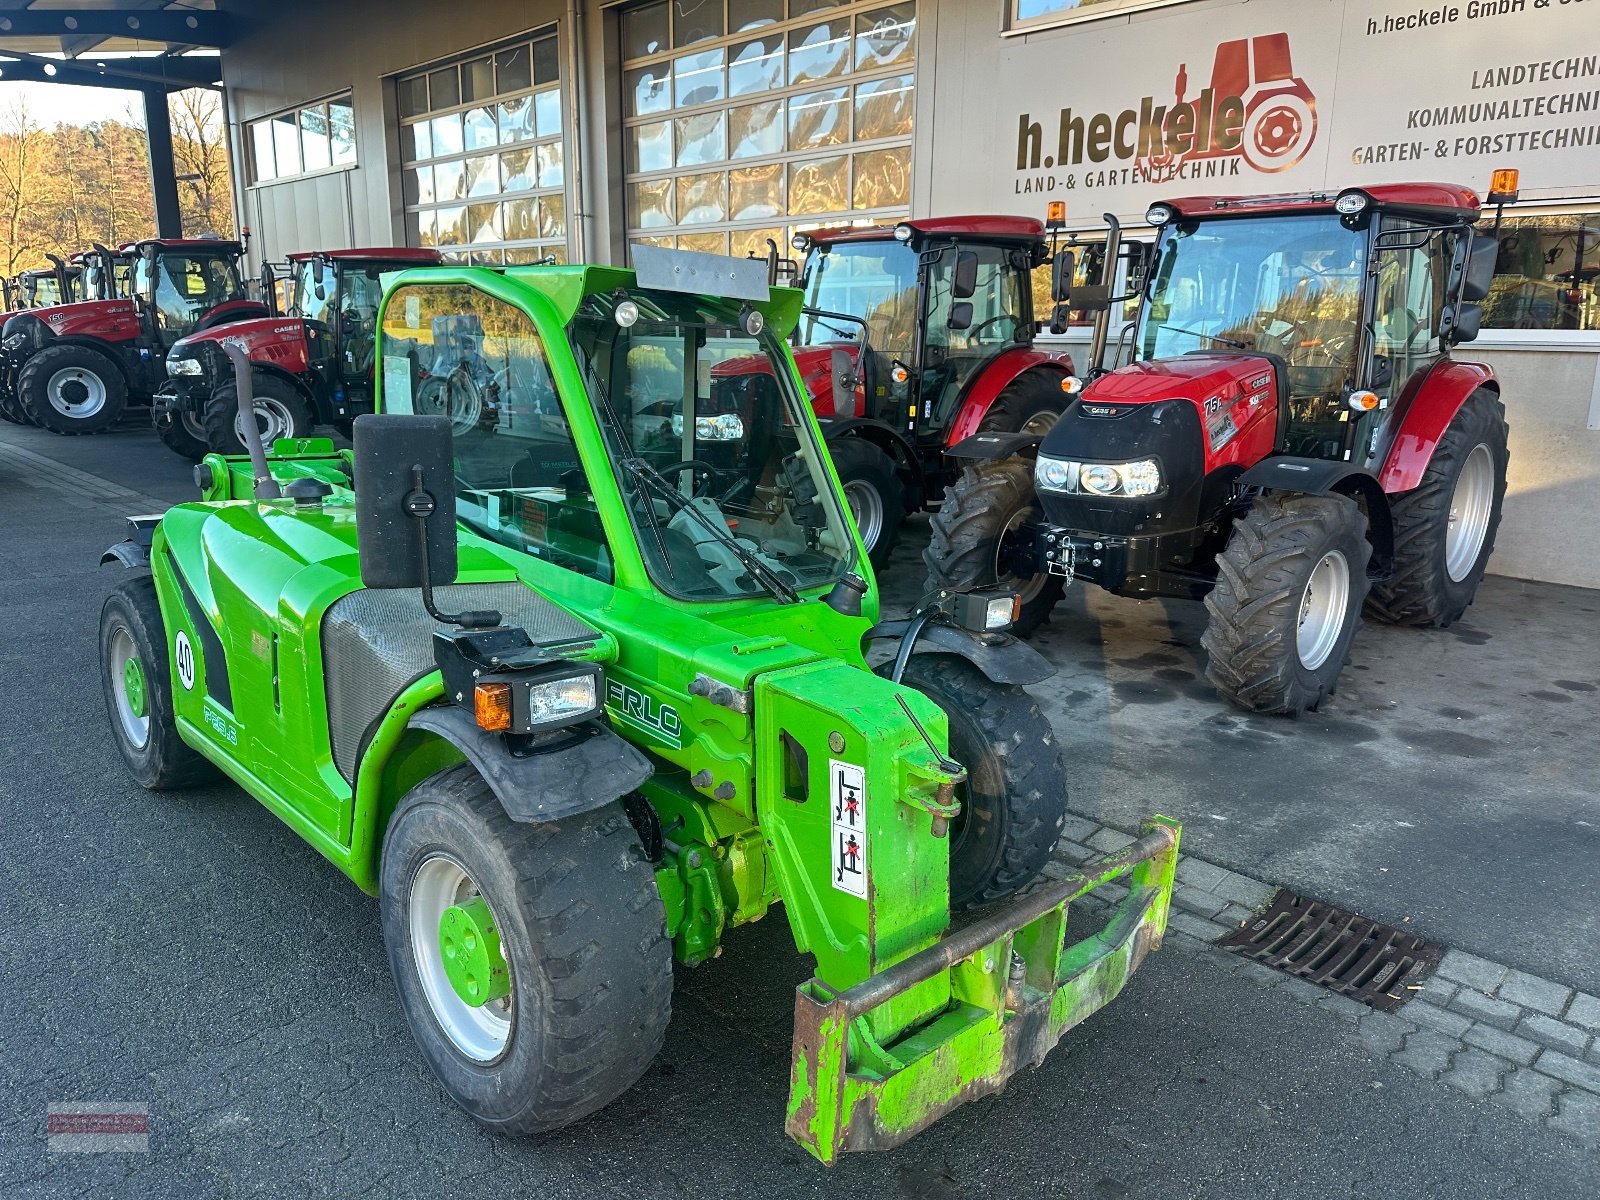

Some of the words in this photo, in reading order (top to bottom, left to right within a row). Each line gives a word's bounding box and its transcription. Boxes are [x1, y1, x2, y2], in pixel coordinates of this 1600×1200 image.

[1366, 4, 1460, 36] h.heckele
[1471, 54, 1600, 90] LANDTECHN
[1016, 87, 1245, 171] h.heckele
[1352, 141, 1430, 165] GARTEN-
[1434, 139, 1448, 158] &
[1085, 157, 1241, 188] GARTENTECHNIK
[48, 313, 64, 322] 150
[274, 325, 293, 334] CASE
[179, 641, 192, 681] 40
